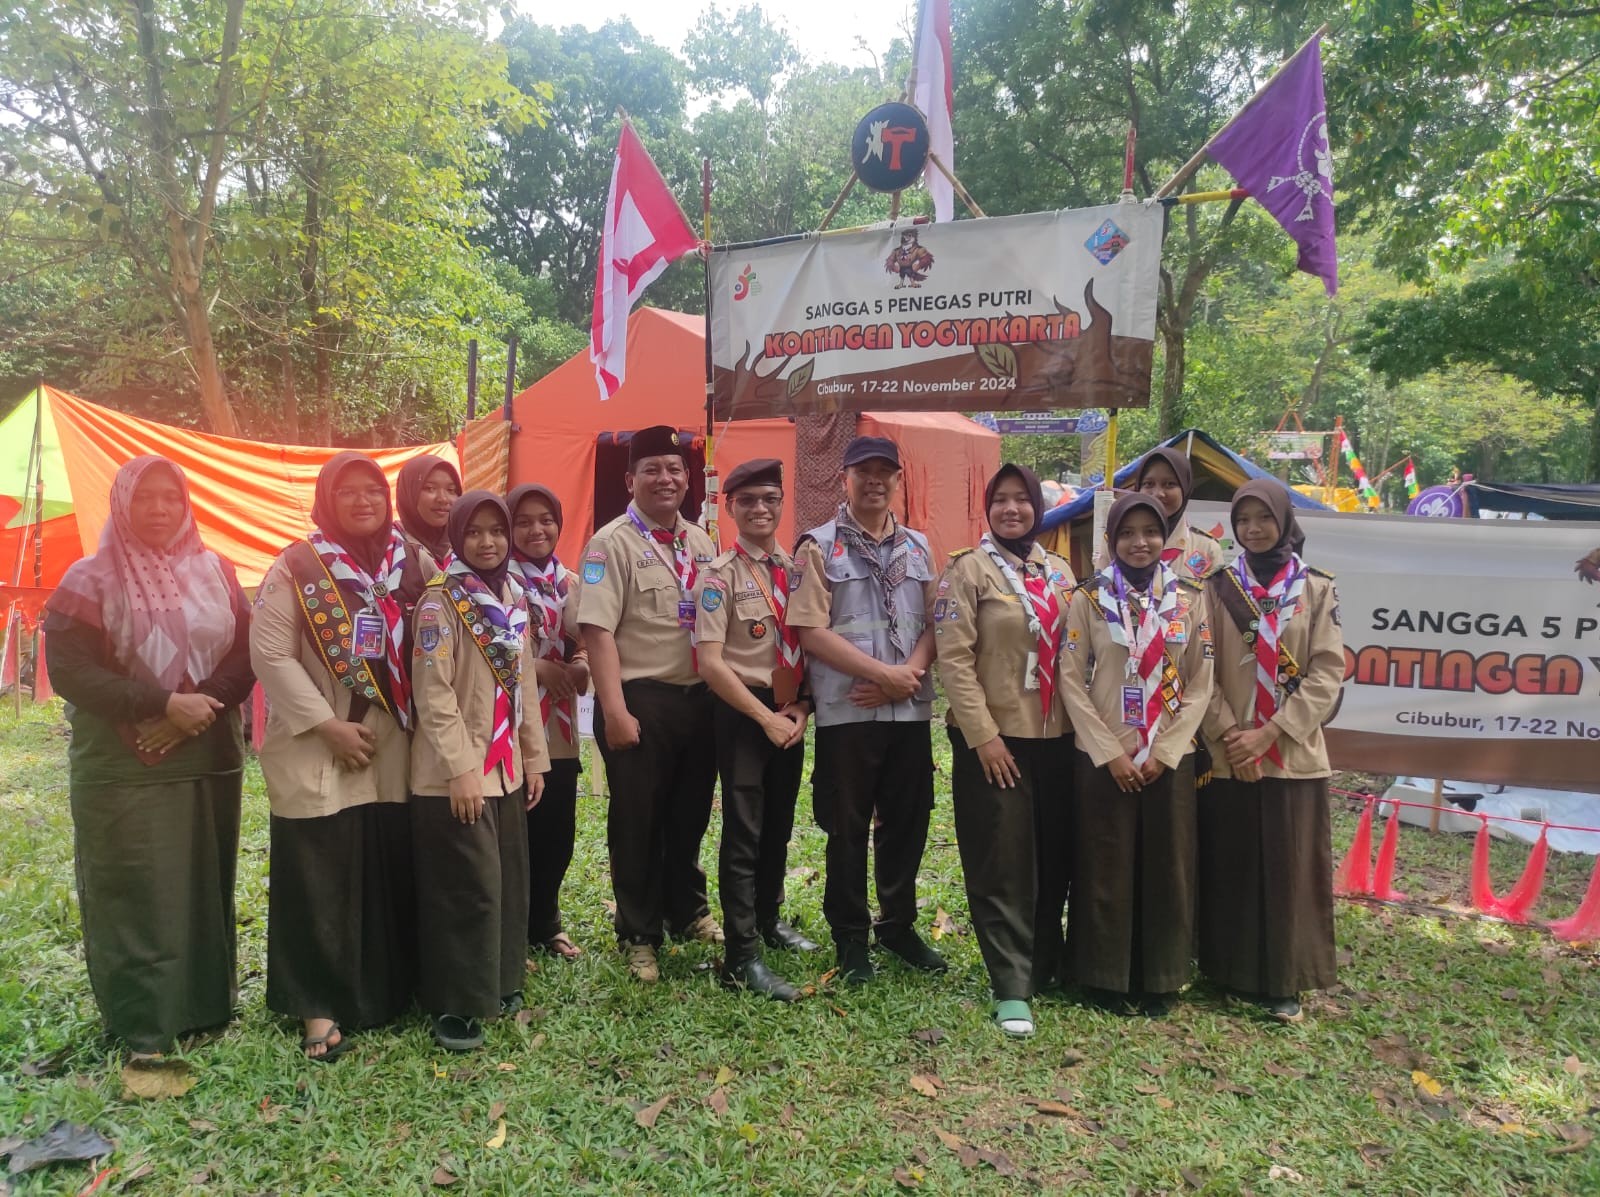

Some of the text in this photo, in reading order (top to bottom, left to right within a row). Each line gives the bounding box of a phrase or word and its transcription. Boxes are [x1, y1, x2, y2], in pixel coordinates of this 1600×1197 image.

[806, 290, 1032, 320] SANGGA 5 PENEGAS PUTRI
[764, 312, 1081, 358] KONTINGEN YOGYAKARTA
[817, 377, 1017, 395] Cibubur, 17-22 November 2024
[1371, 608, 1528, 637] SANGGA
[1540, 616, 1562, 639] 5
[1343, 644, 1584, 696] NTINGEN
[1395, 711, 1485, 732] Cibubur,
[1495, 716, 1557, 735] 17-22
